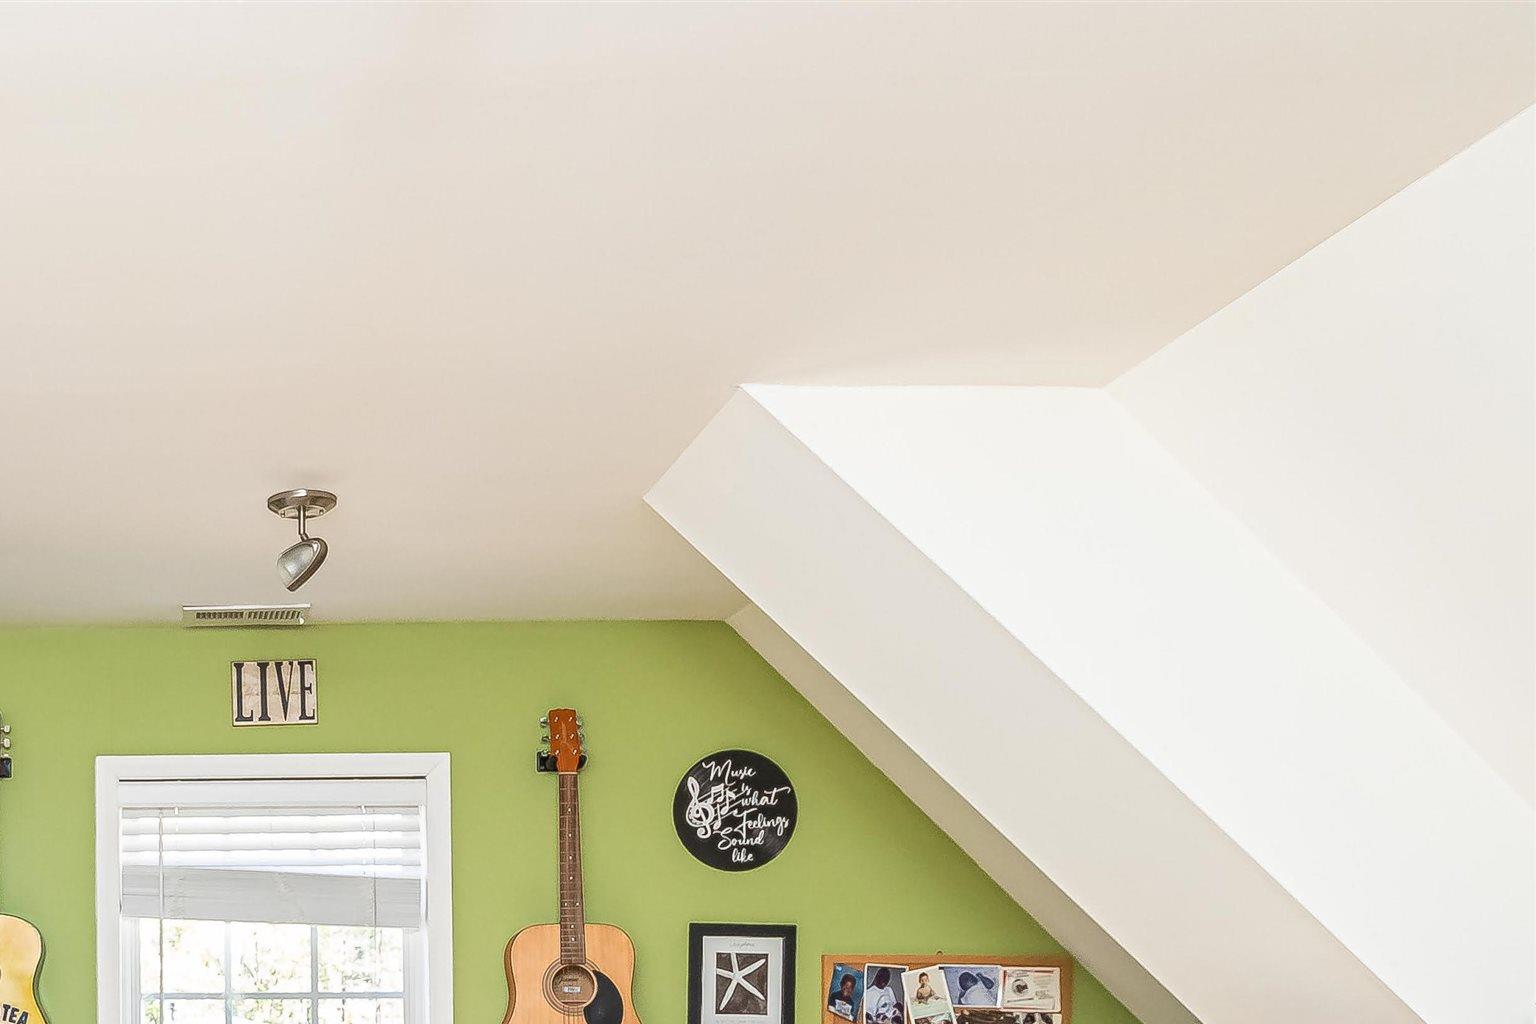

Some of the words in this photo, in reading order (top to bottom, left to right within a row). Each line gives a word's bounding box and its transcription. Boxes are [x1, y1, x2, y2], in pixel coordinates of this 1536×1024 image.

[233, 661, 315, 721] LIVE
[702, 759, 756, 786] Music
[741, 783, 753, 796] is
[741, 786, 791, 806] what
[732, 808, 789, 839] Feelings
[712, 827, 765, 850] Sound
[731, 848, 754, 863] like
